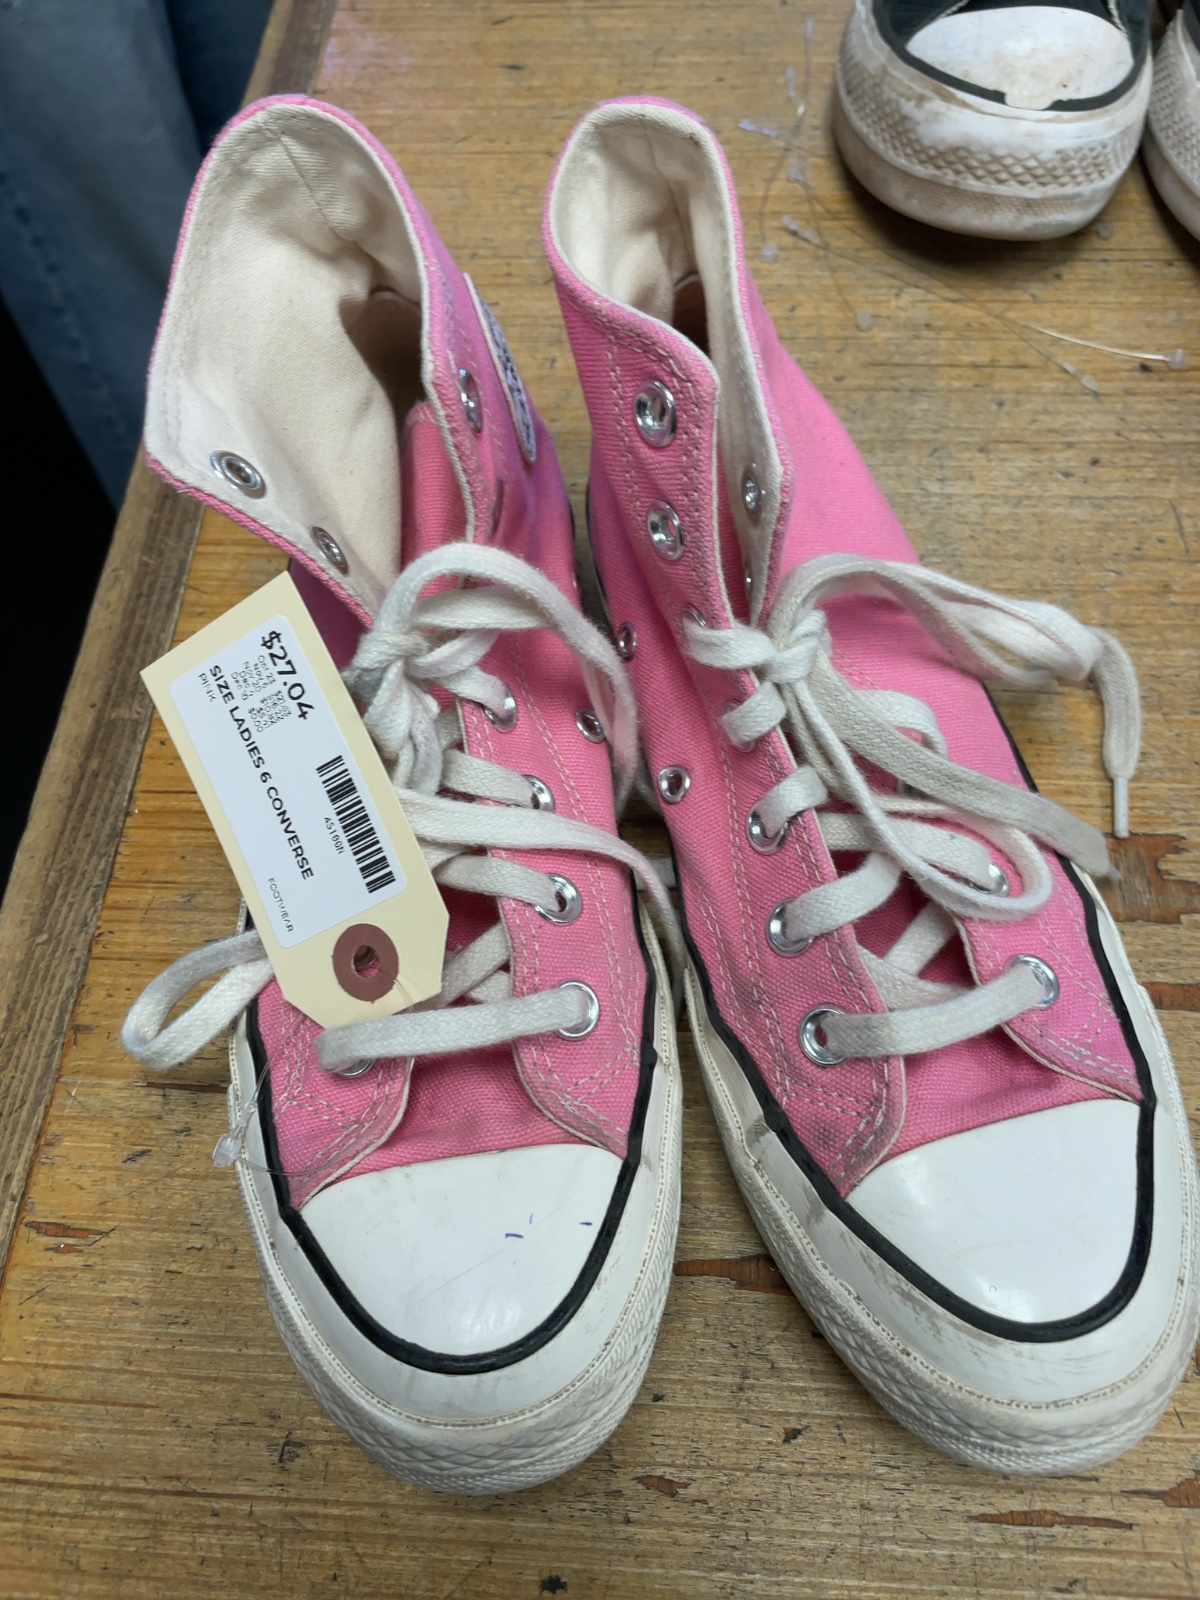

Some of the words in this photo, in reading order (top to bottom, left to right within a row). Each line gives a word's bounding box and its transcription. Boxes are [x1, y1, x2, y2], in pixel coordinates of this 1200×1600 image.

[243, 661, 255, 680] Nov
[251, 680, 262, 692] 20
[253, 663, 264, 681] Nov
[257, 655, 269, 671] Oct
[261, 631, 314, 720] $27.04
[198, 673, 216, 702] PINK
[238, 670, 251, 689] Dec
[231, 672, 243, 690] Dec
[248, 707, 264, 733] $0.00
[209, 665, 235, 704] SIZE
[229, 706, 265, 768] LADIES
[260, 772, 272, 783] 6
[267, 786, 314, 880] CONVERSE
[268, 877, 293, 932] FOOTWEAR
